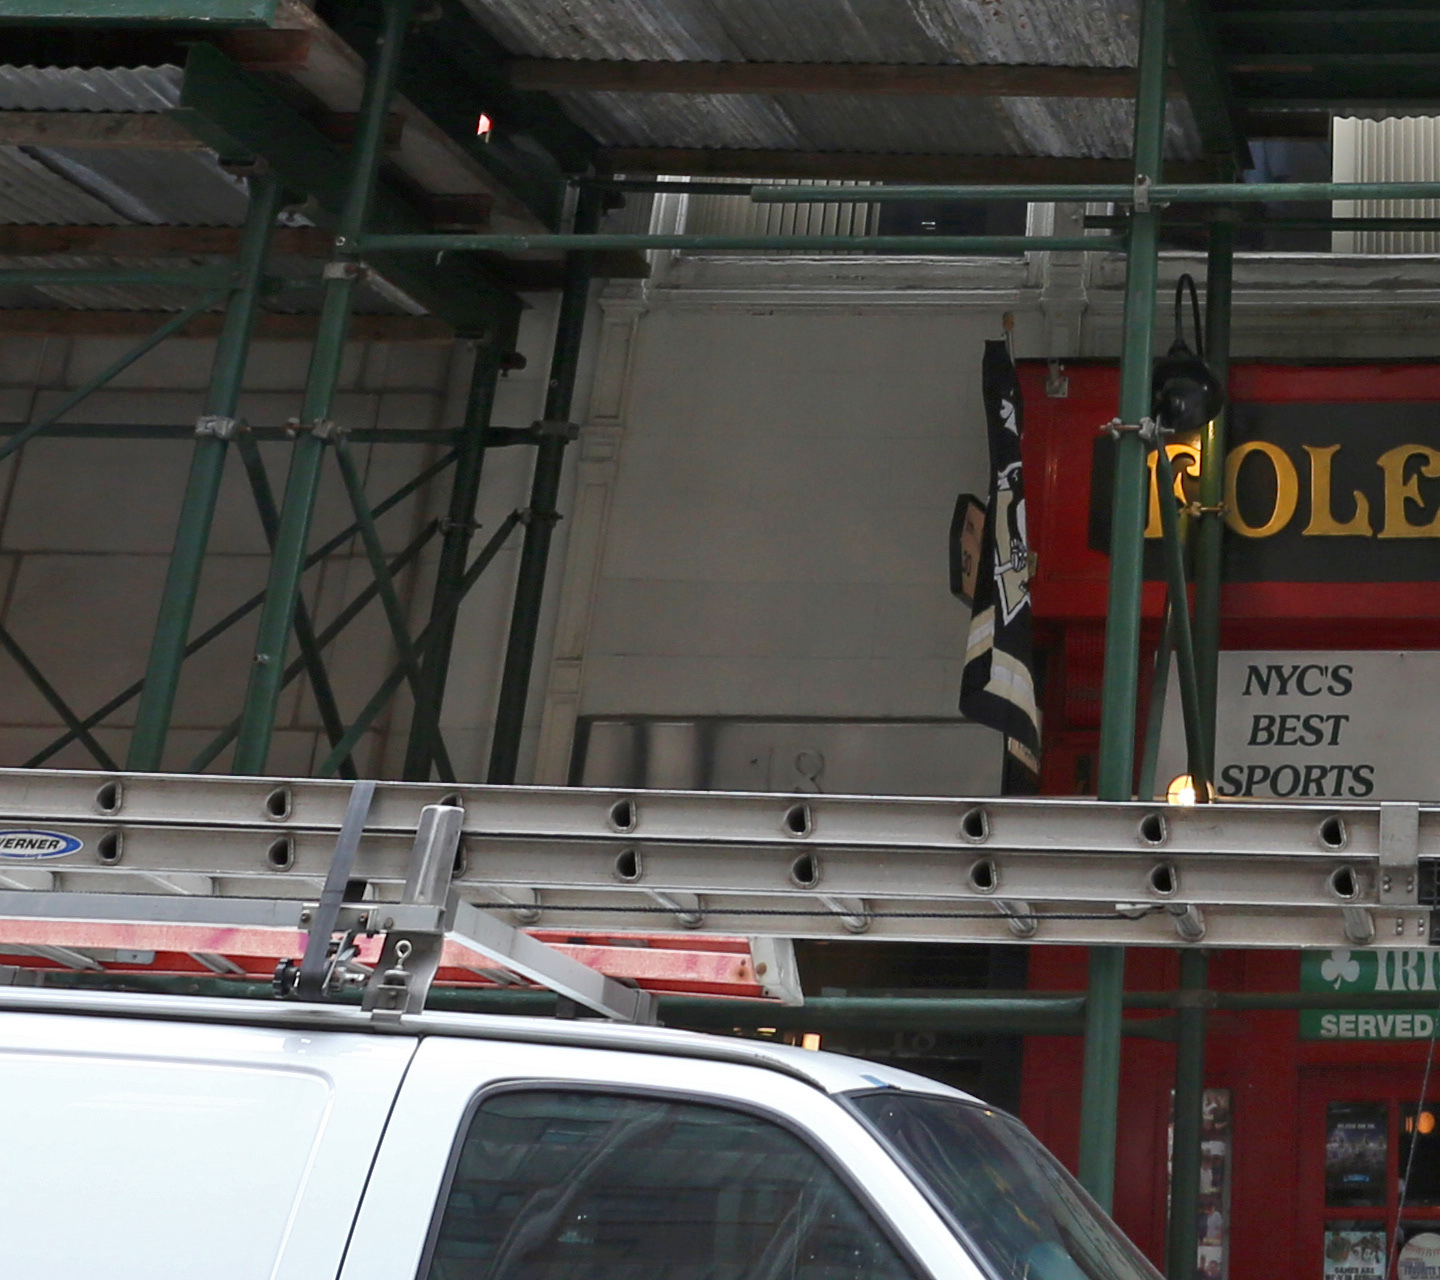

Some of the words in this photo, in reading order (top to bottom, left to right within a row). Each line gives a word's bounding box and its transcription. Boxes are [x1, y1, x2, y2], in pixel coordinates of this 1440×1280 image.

[1242, 663, 1353, 697] NYC'S
[1248, 714, 1349, 747] BEST
[1218, 764, 1375, 799] SPORTS
[1319, 1013, 1437, 1038] SERVED
